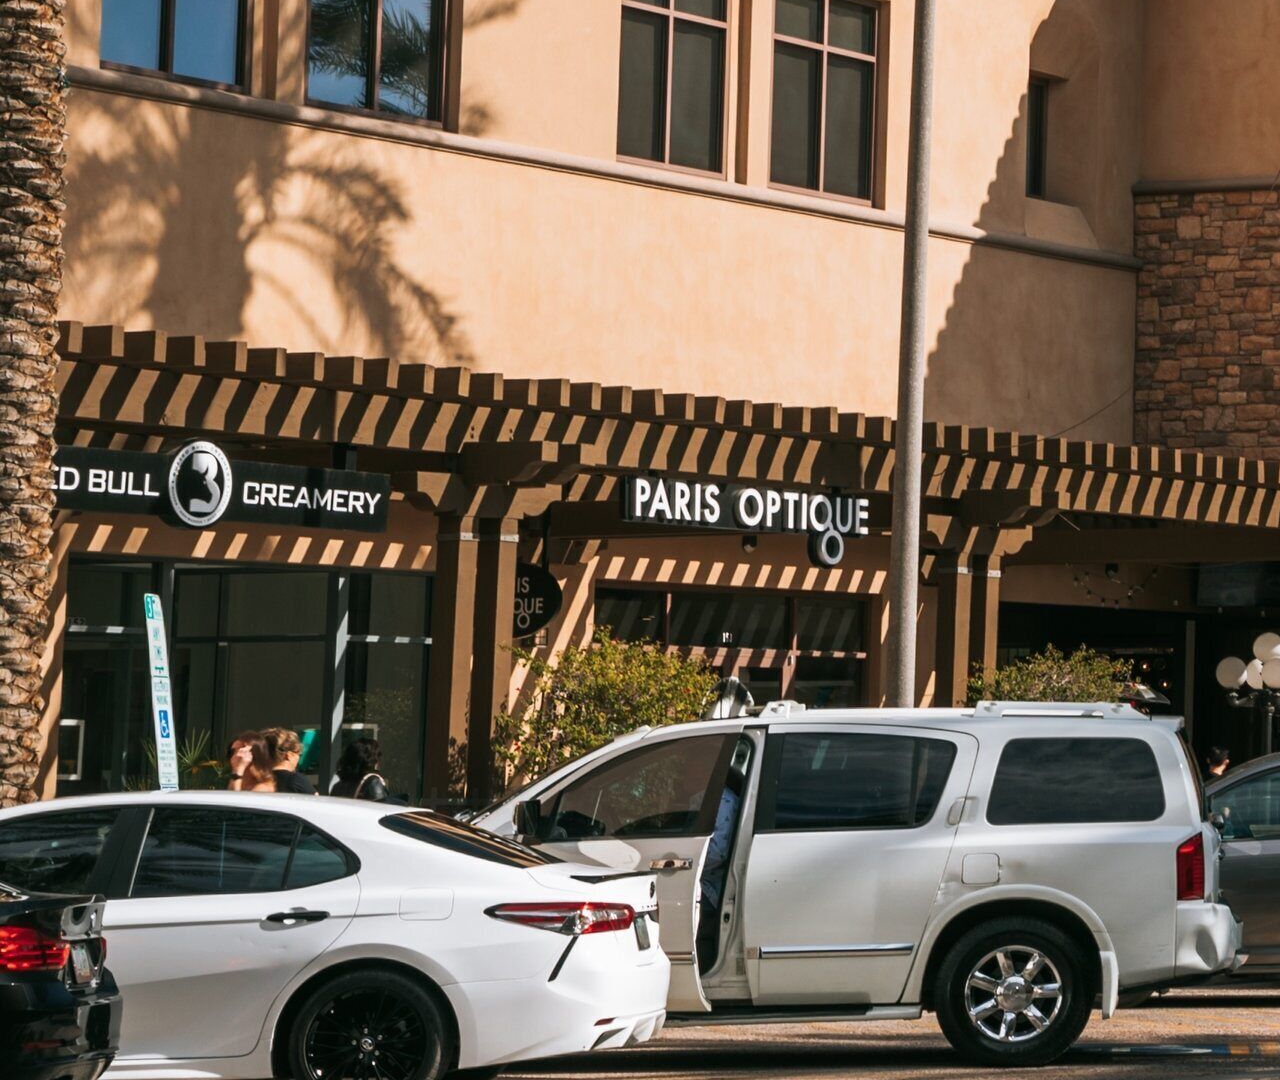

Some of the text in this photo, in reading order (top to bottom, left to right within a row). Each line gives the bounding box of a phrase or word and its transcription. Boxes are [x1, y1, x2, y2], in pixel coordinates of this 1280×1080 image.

[88, 468, 160, 497] BULL
[242, 481, 382, 516] CREAMERY
[634, 477, 870, 565] PARIS OPTIQUE
